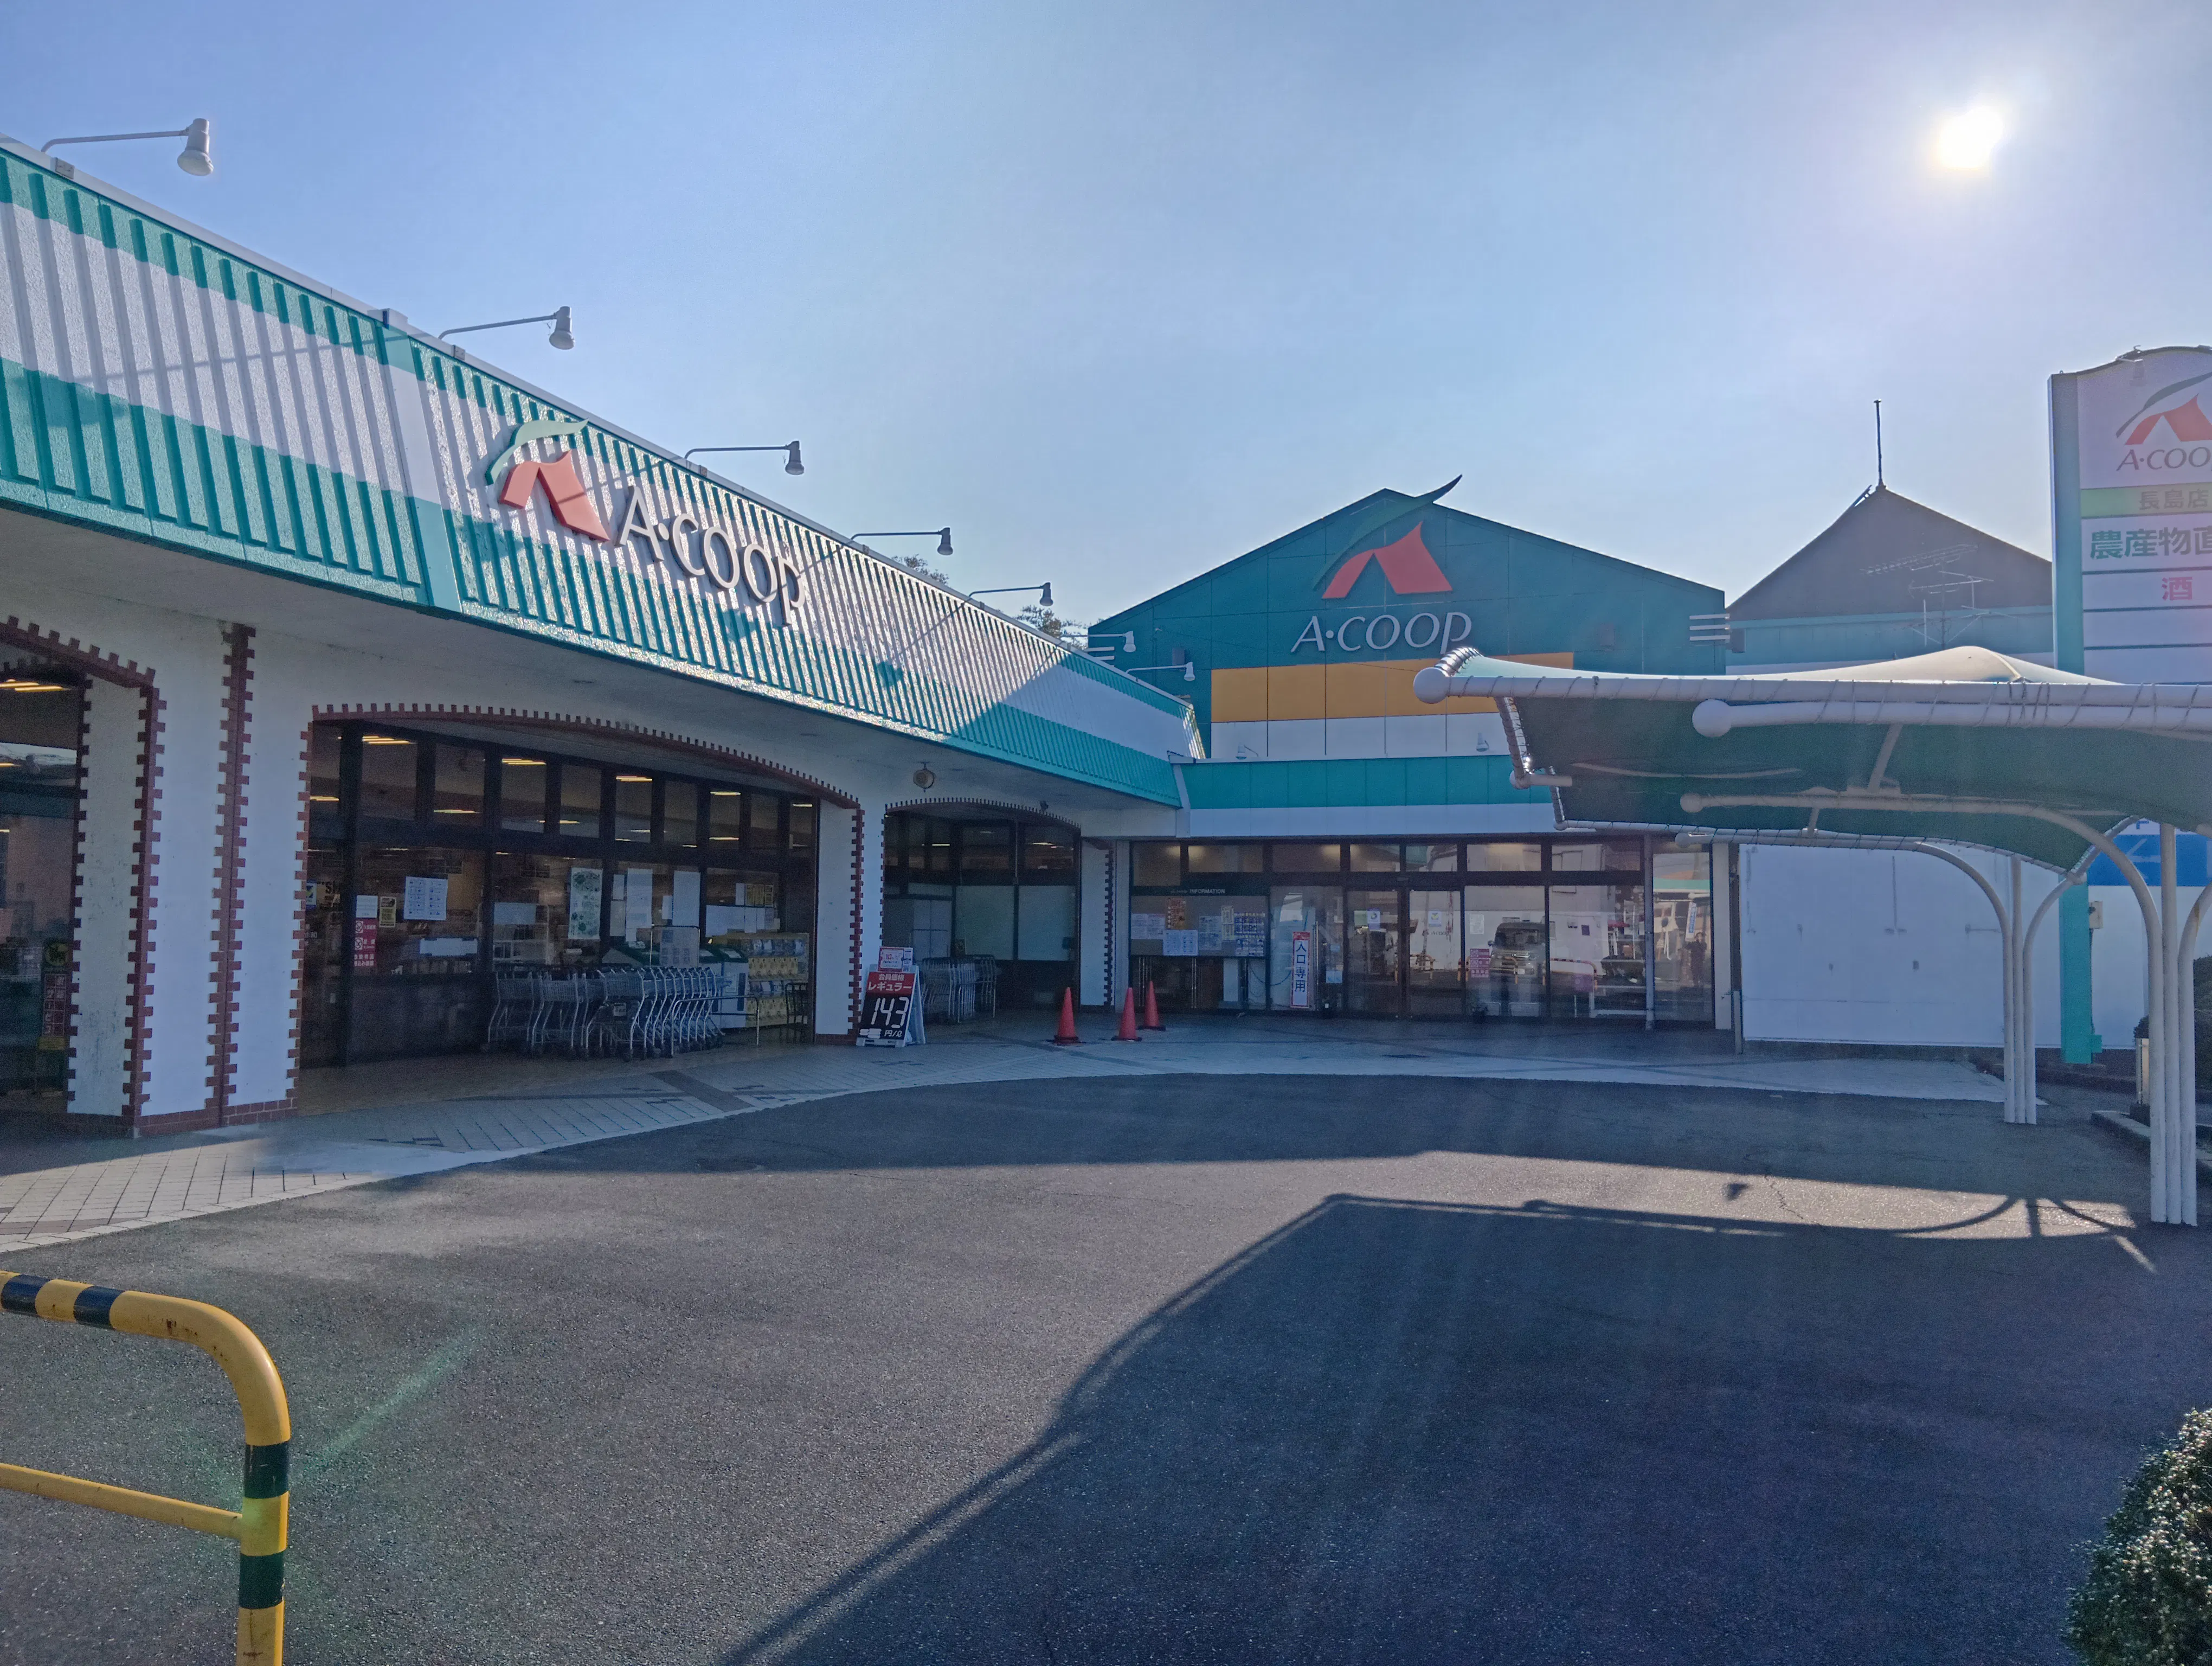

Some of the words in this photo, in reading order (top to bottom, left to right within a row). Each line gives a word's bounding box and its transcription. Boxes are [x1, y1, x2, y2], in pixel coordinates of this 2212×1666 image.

[2115, 446, 2212, 471] A·COO
[2139, 488, 2209, 510] 長島店
[2090, 525, 2212, 560] 農産物直
[2161, 576, 2193, 601] 酒
[1294, 941, 1307, 992] 入口専用
[868, 981, 912, 991] レギュラー
[871, 997, 909, 1029] 143
